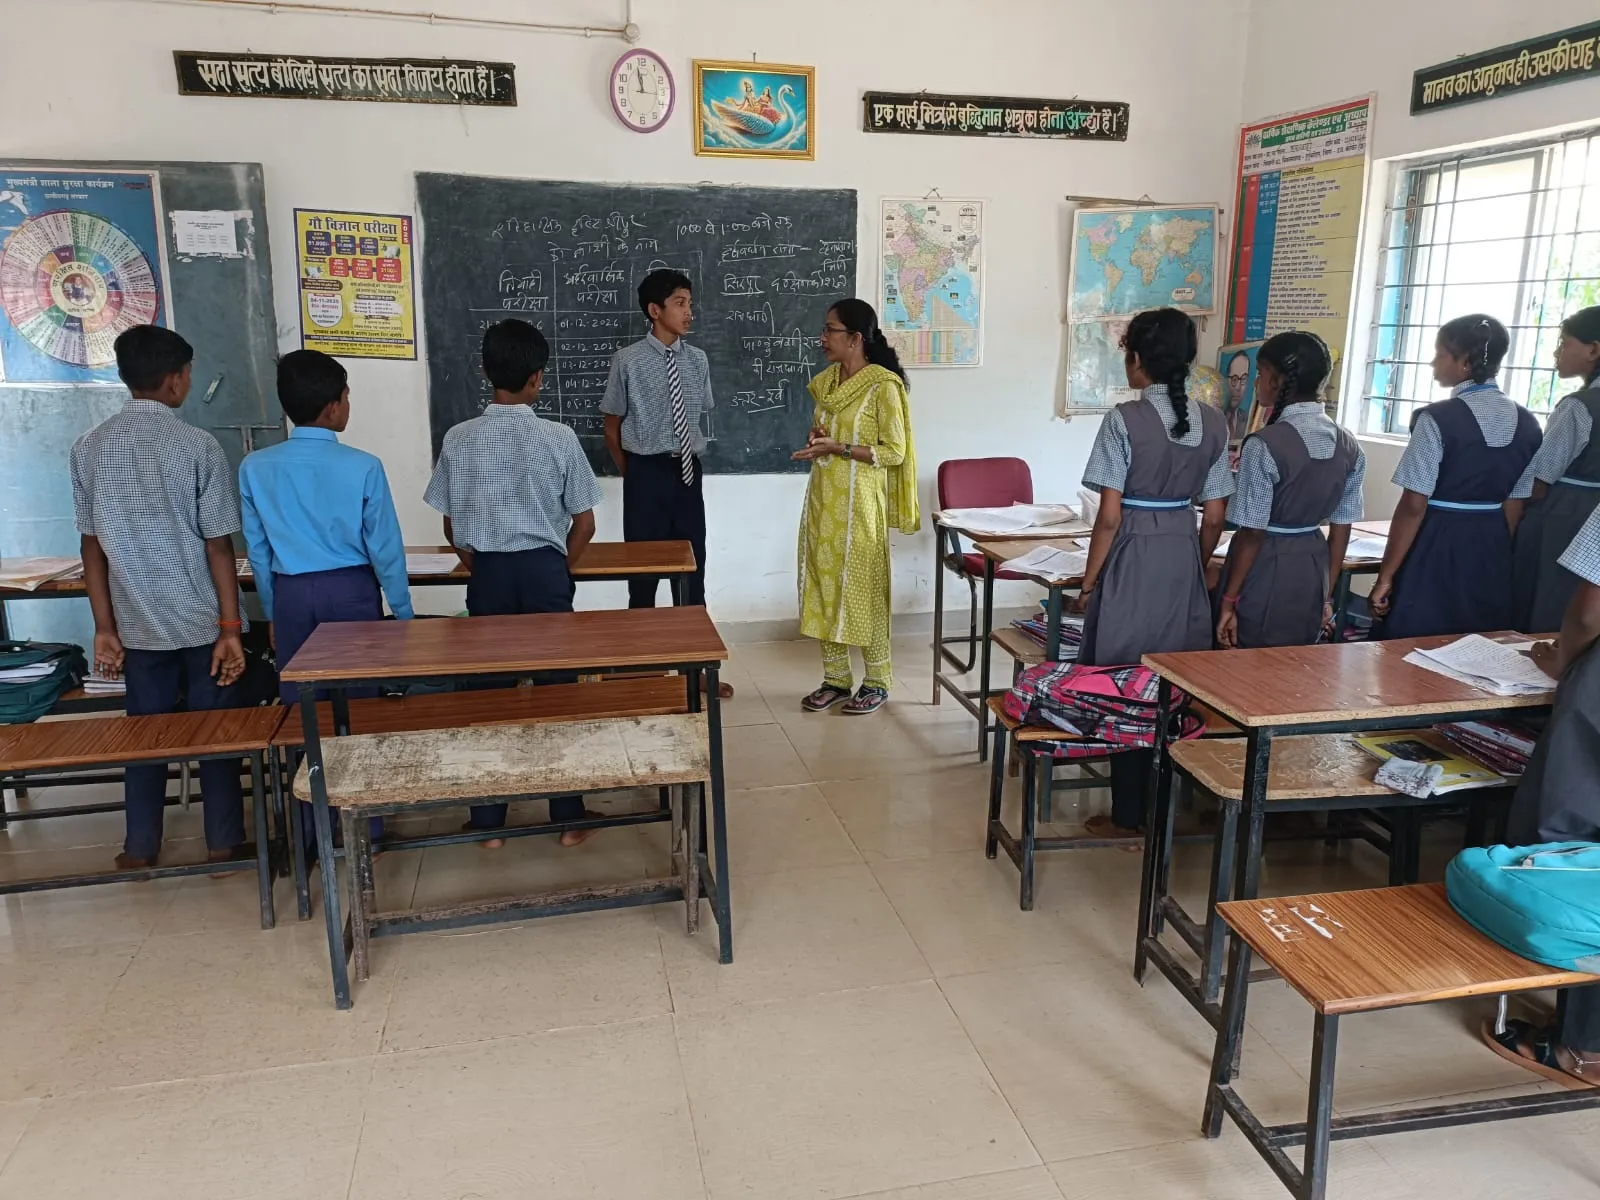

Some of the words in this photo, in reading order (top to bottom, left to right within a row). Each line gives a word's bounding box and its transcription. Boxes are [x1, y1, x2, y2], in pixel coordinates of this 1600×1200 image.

[197, 60, 232, 92] सदा
[231, 61, 270, 93] सत्य
[318, 64, 351, 94] सत्य
[351, 65, 373, 91] का
[372, 65, 402, 96] सदा
[402, 64, 445, 92] विजय
[446, 64, 476, 98] होता
[1423, 77, 1456, 104] मानव
[1455, 70, 1473, 96] का
[1472, 59, 1517, 96] अनुभव
[873, 103, 895, 126] एक
[920, 101, 946, 125] मित्र
[1004, 108, 1025, 132] शत्रु
[6, 177, 38, 189] मुख्यमंत्री
[40, 179, 60, 188] शाला
[62, 179, 84, 191] सुरक्षा
[86, 178, 115, 189] कार्यक्रम
[308, 216, 322, 230] गौ
[326, 216, 361, 232] विज्ञान
[364, 219, 398, 235] परीक्षा
[562, 360, 612, 370] 03-12-202
